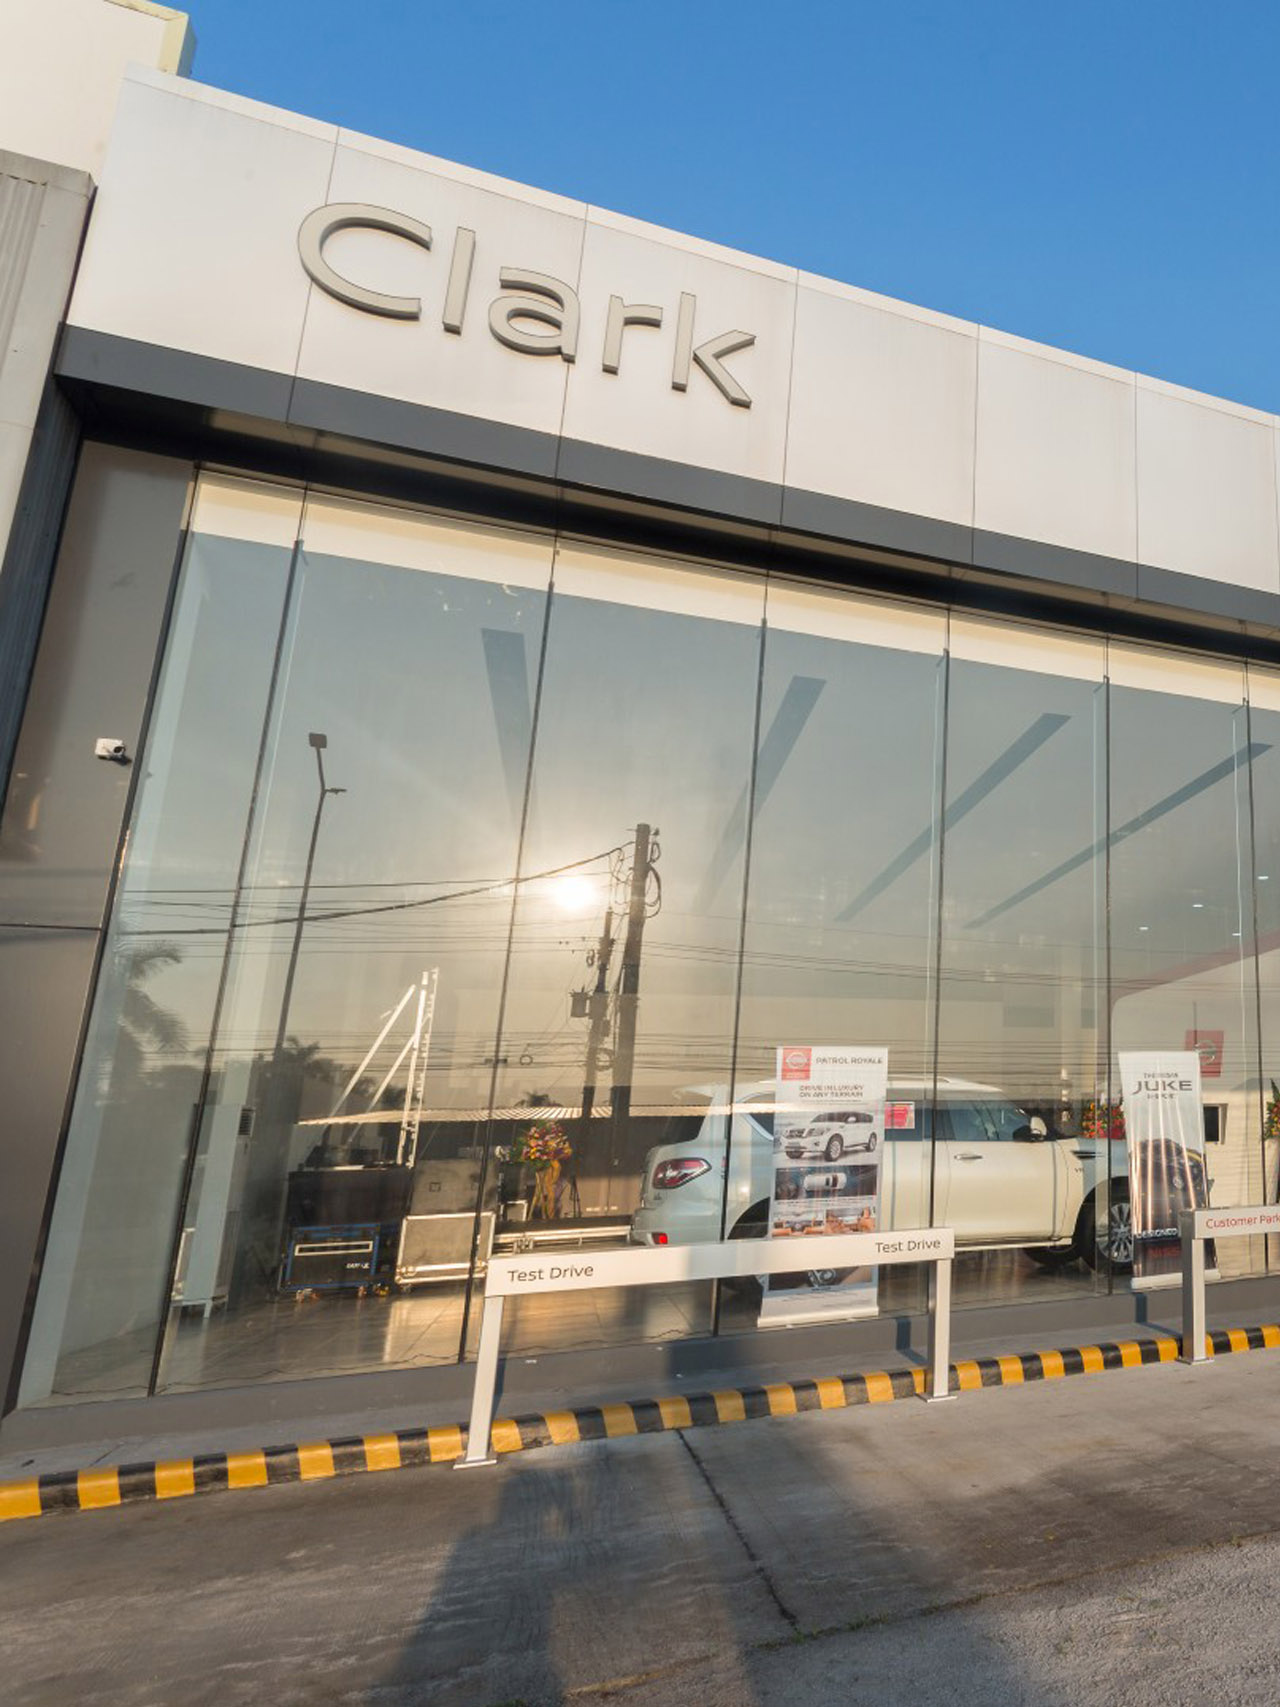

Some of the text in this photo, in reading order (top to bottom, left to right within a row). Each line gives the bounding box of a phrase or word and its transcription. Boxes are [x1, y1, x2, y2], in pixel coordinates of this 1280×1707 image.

[296, 202, 757, 409] Clark
[815, 1056, 883, 1065] PATROL ROYALE
[1132, 1080, 1193, 1095] JUKE
[1206, 1216, 1258, 1229] Customer
[875, 1239, 942, 1253] Test Drive
[507, 1264, 594, 1282] Test Drive
